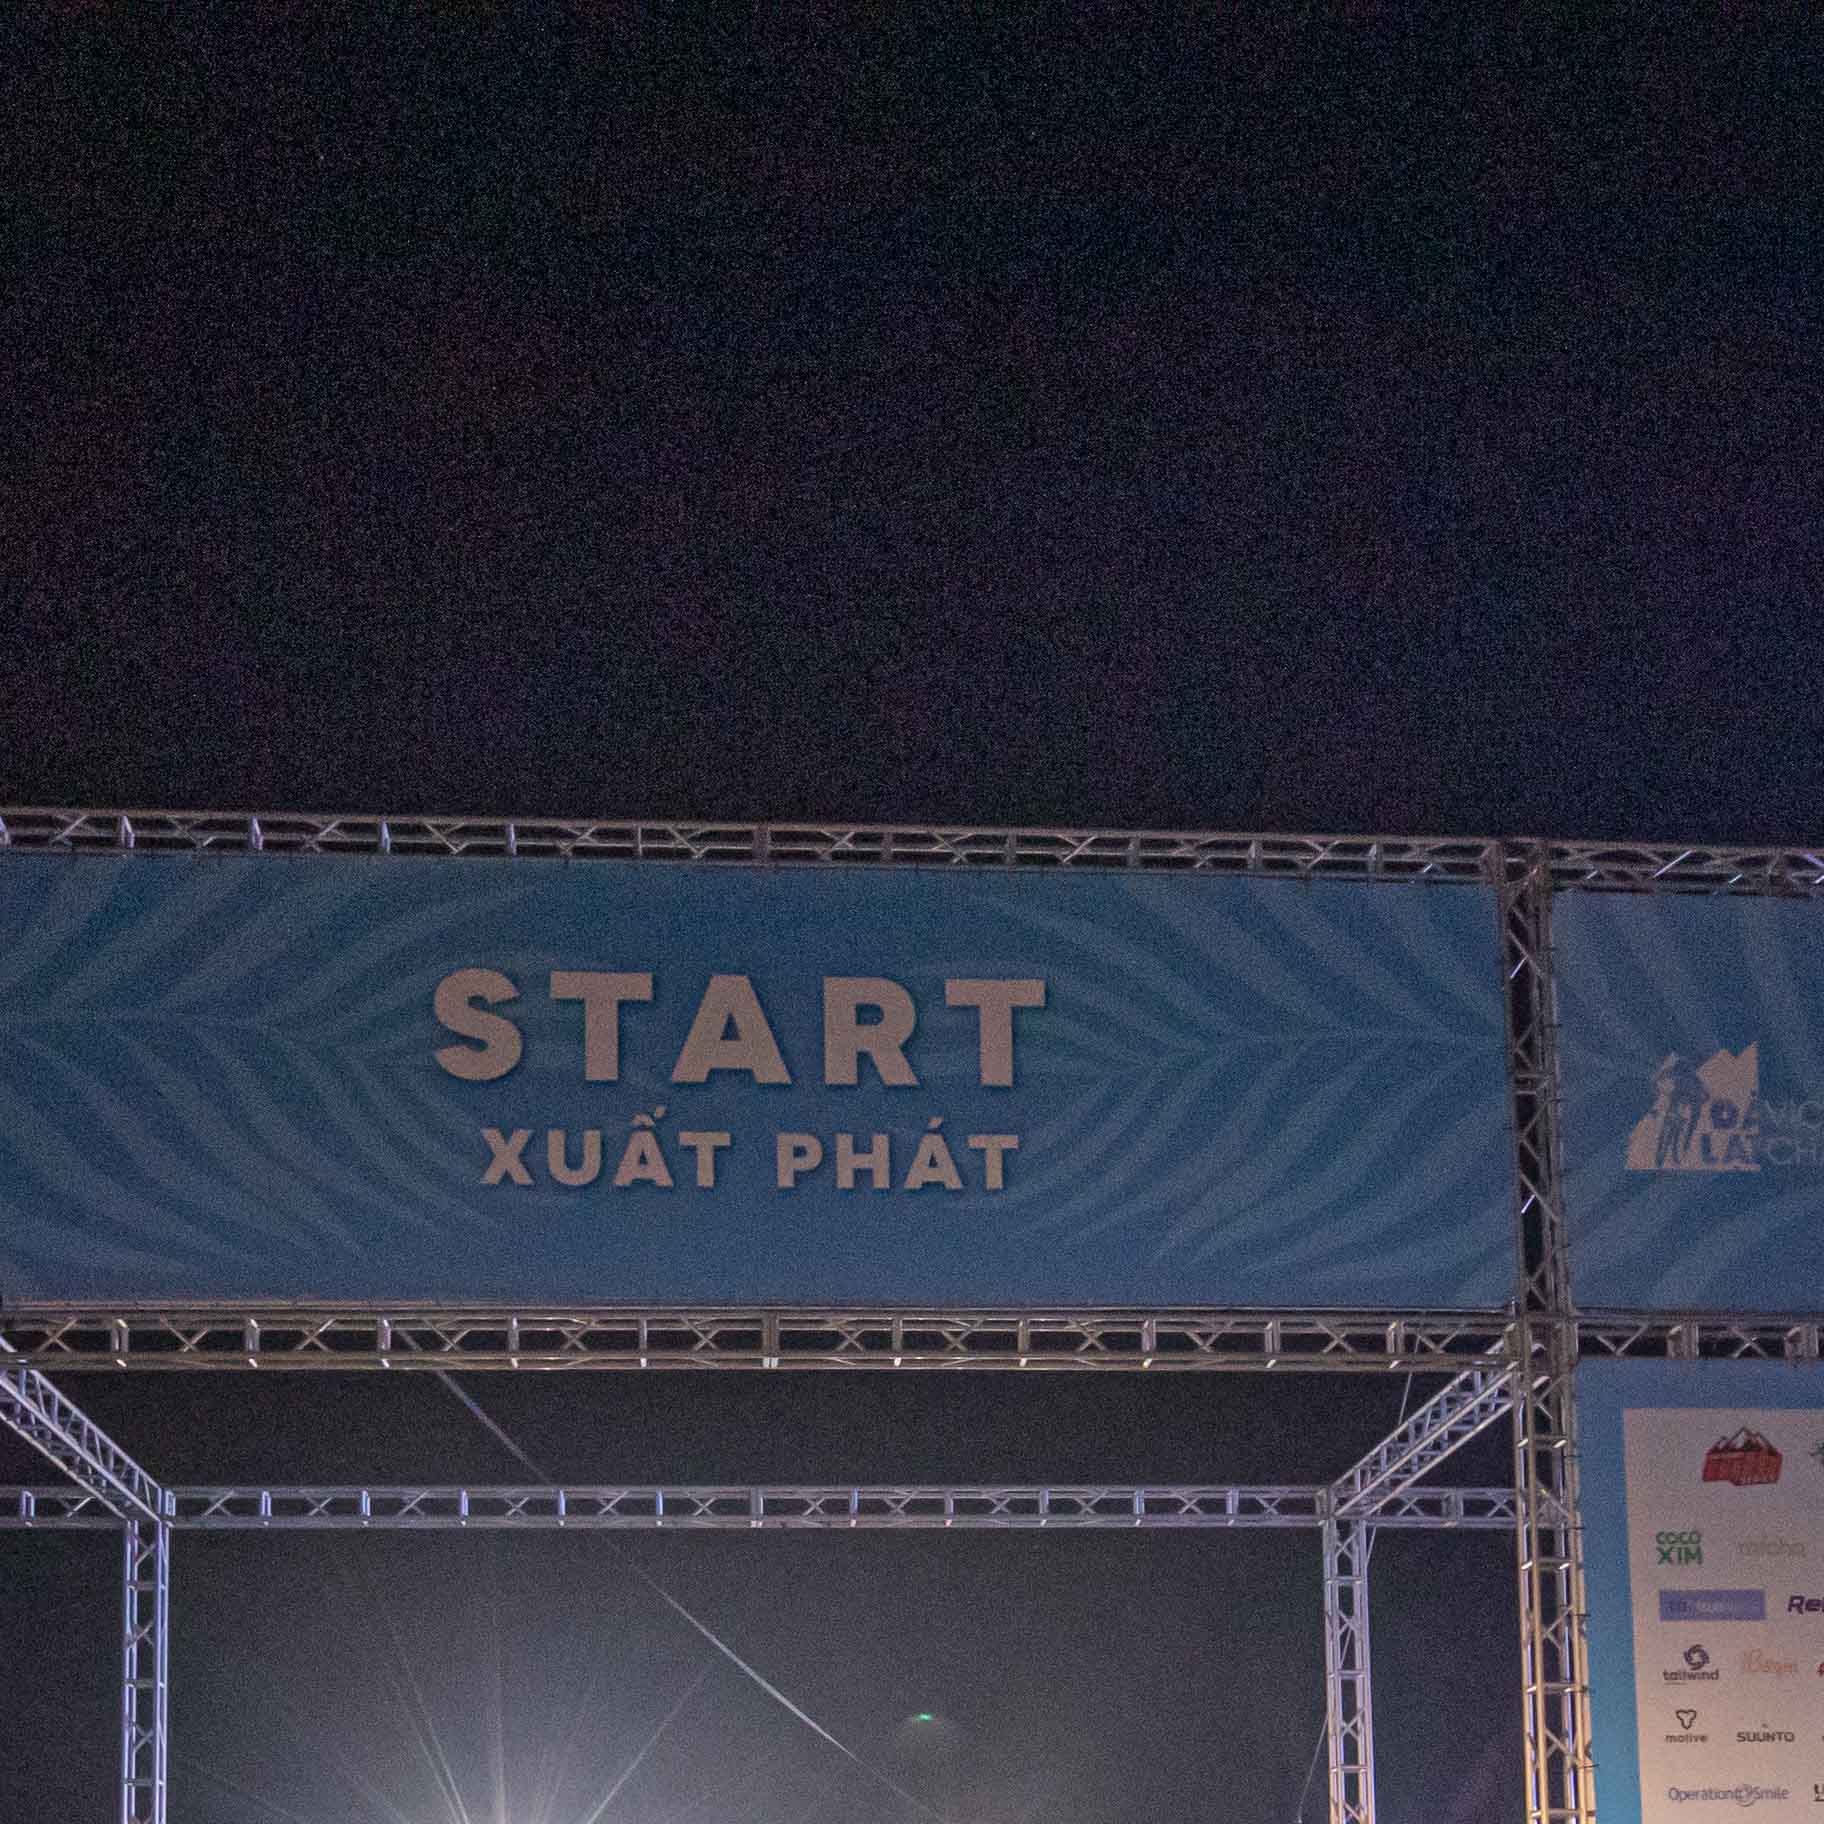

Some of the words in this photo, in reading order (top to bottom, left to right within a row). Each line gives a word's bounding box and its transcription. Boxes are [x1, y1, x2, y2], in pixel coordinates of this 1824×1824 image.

[434, 967, 1046, 1087] START
[478, 1106, 731, 1188] XUẤT
[776, 1117, 1020, 1191] PHÁT
[1657, 1546, 1703, 1565] XIM
[1663, 1669, 1720, 1682] tailwind
[1736, 1731, 1795, 1743] SUUNTO
[1668, 1785, 1736, 1802] Operation
[1755, 1784, 1790, 1800] Smile
